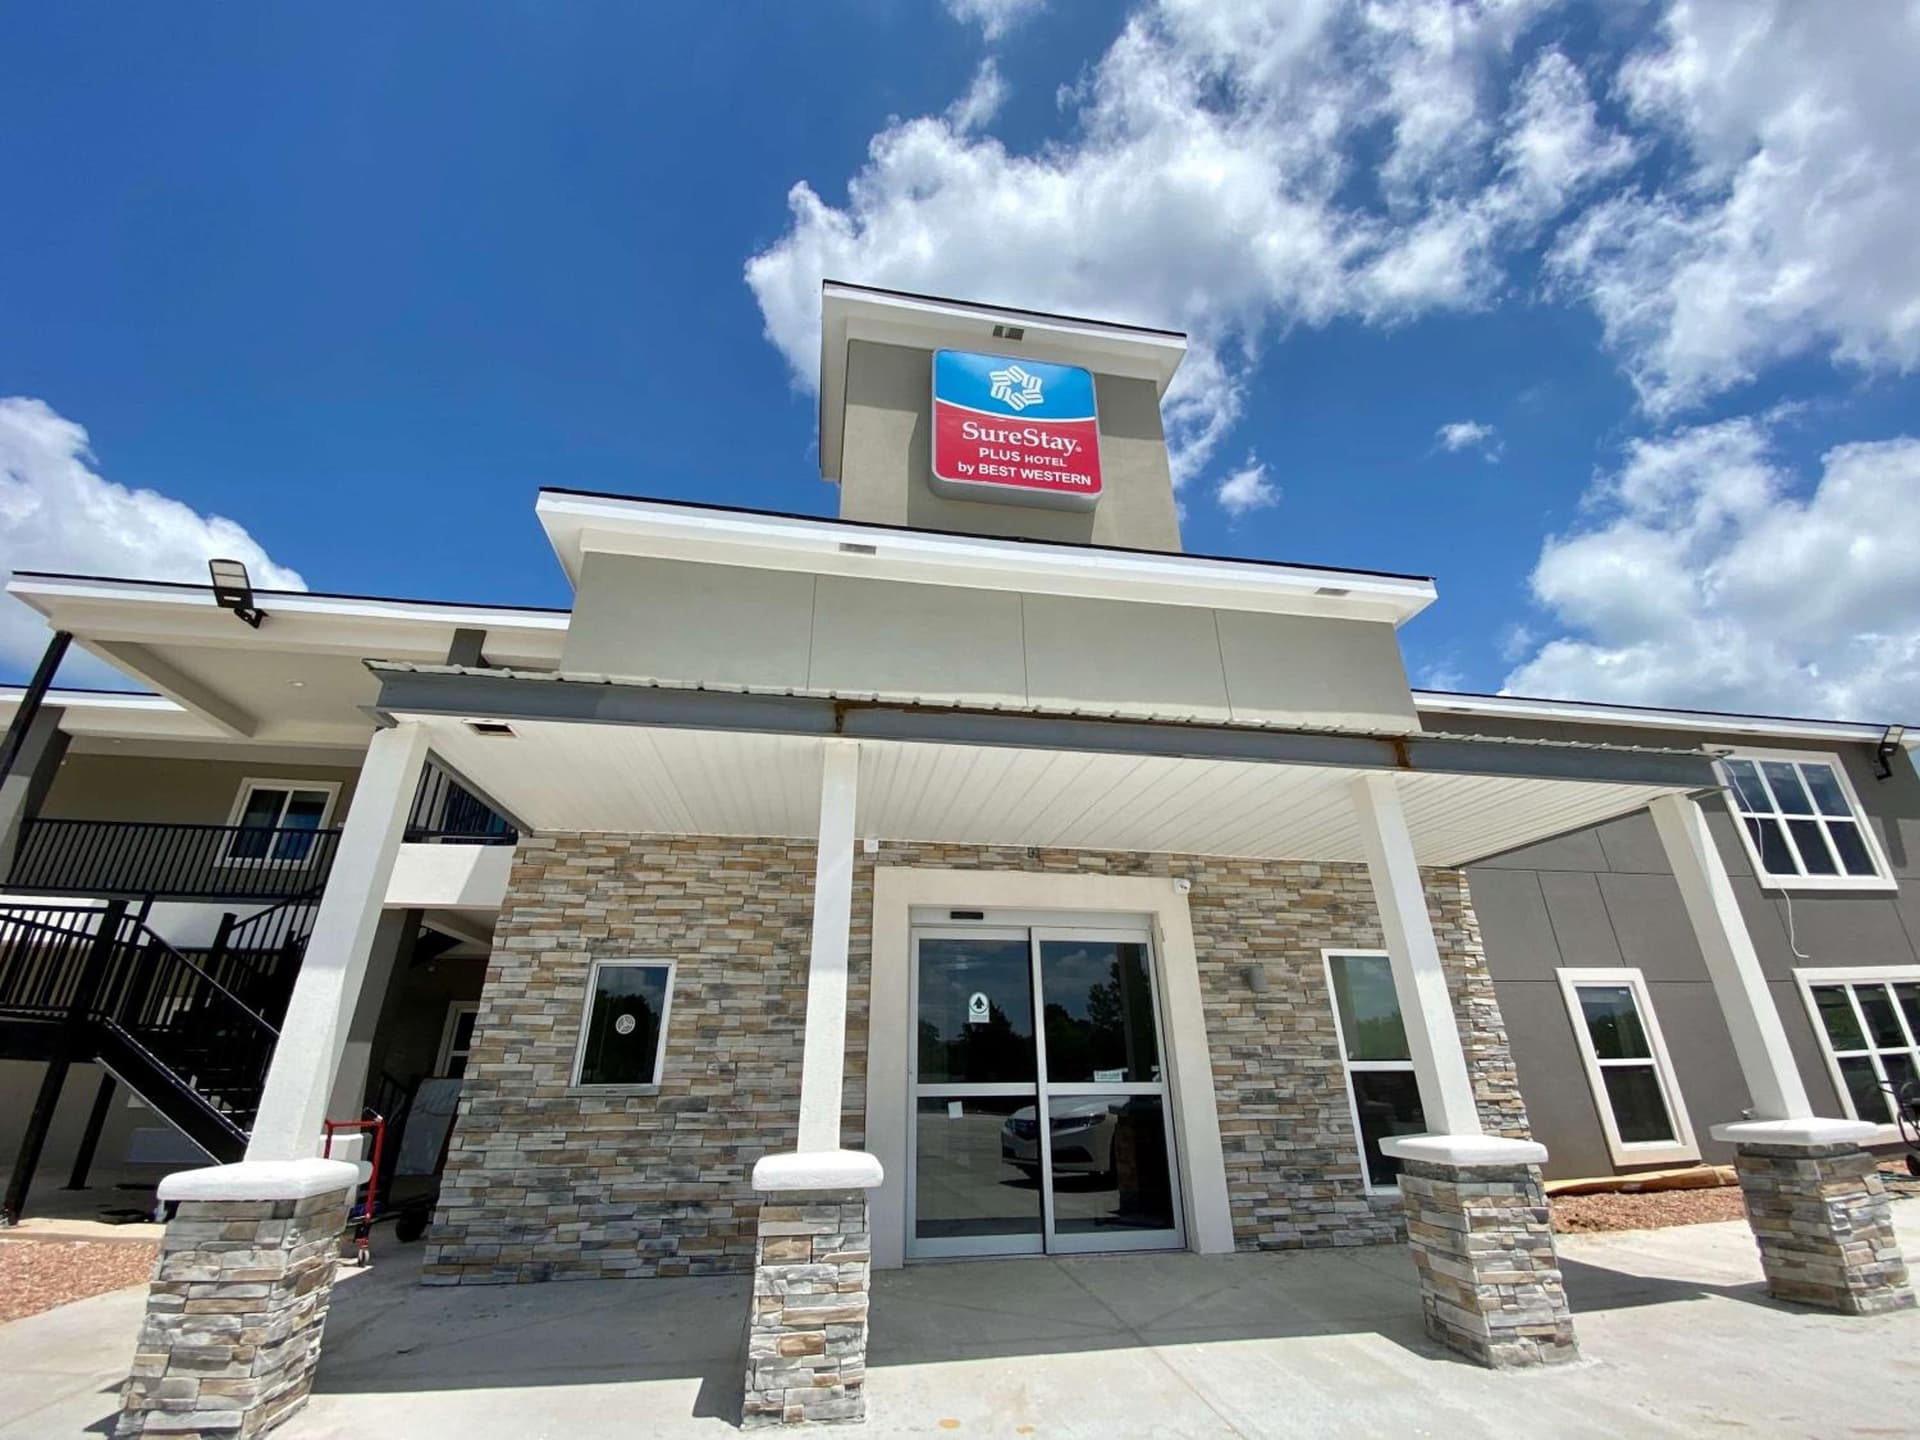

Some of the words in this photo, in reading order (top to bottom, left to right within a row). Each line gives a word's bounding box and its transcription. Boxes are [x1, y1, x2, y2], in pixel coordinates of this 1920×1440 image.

[962, 421, 1079, 456] SureStay
[979, 447, 1021, 462] PLUS
[1024, 454, 1067, 467] HOTEL
[957, 461, 975, 475] by
[978, 463, 1017, 478] BEST
[1020, 467, 1092, 485] WESTERN
